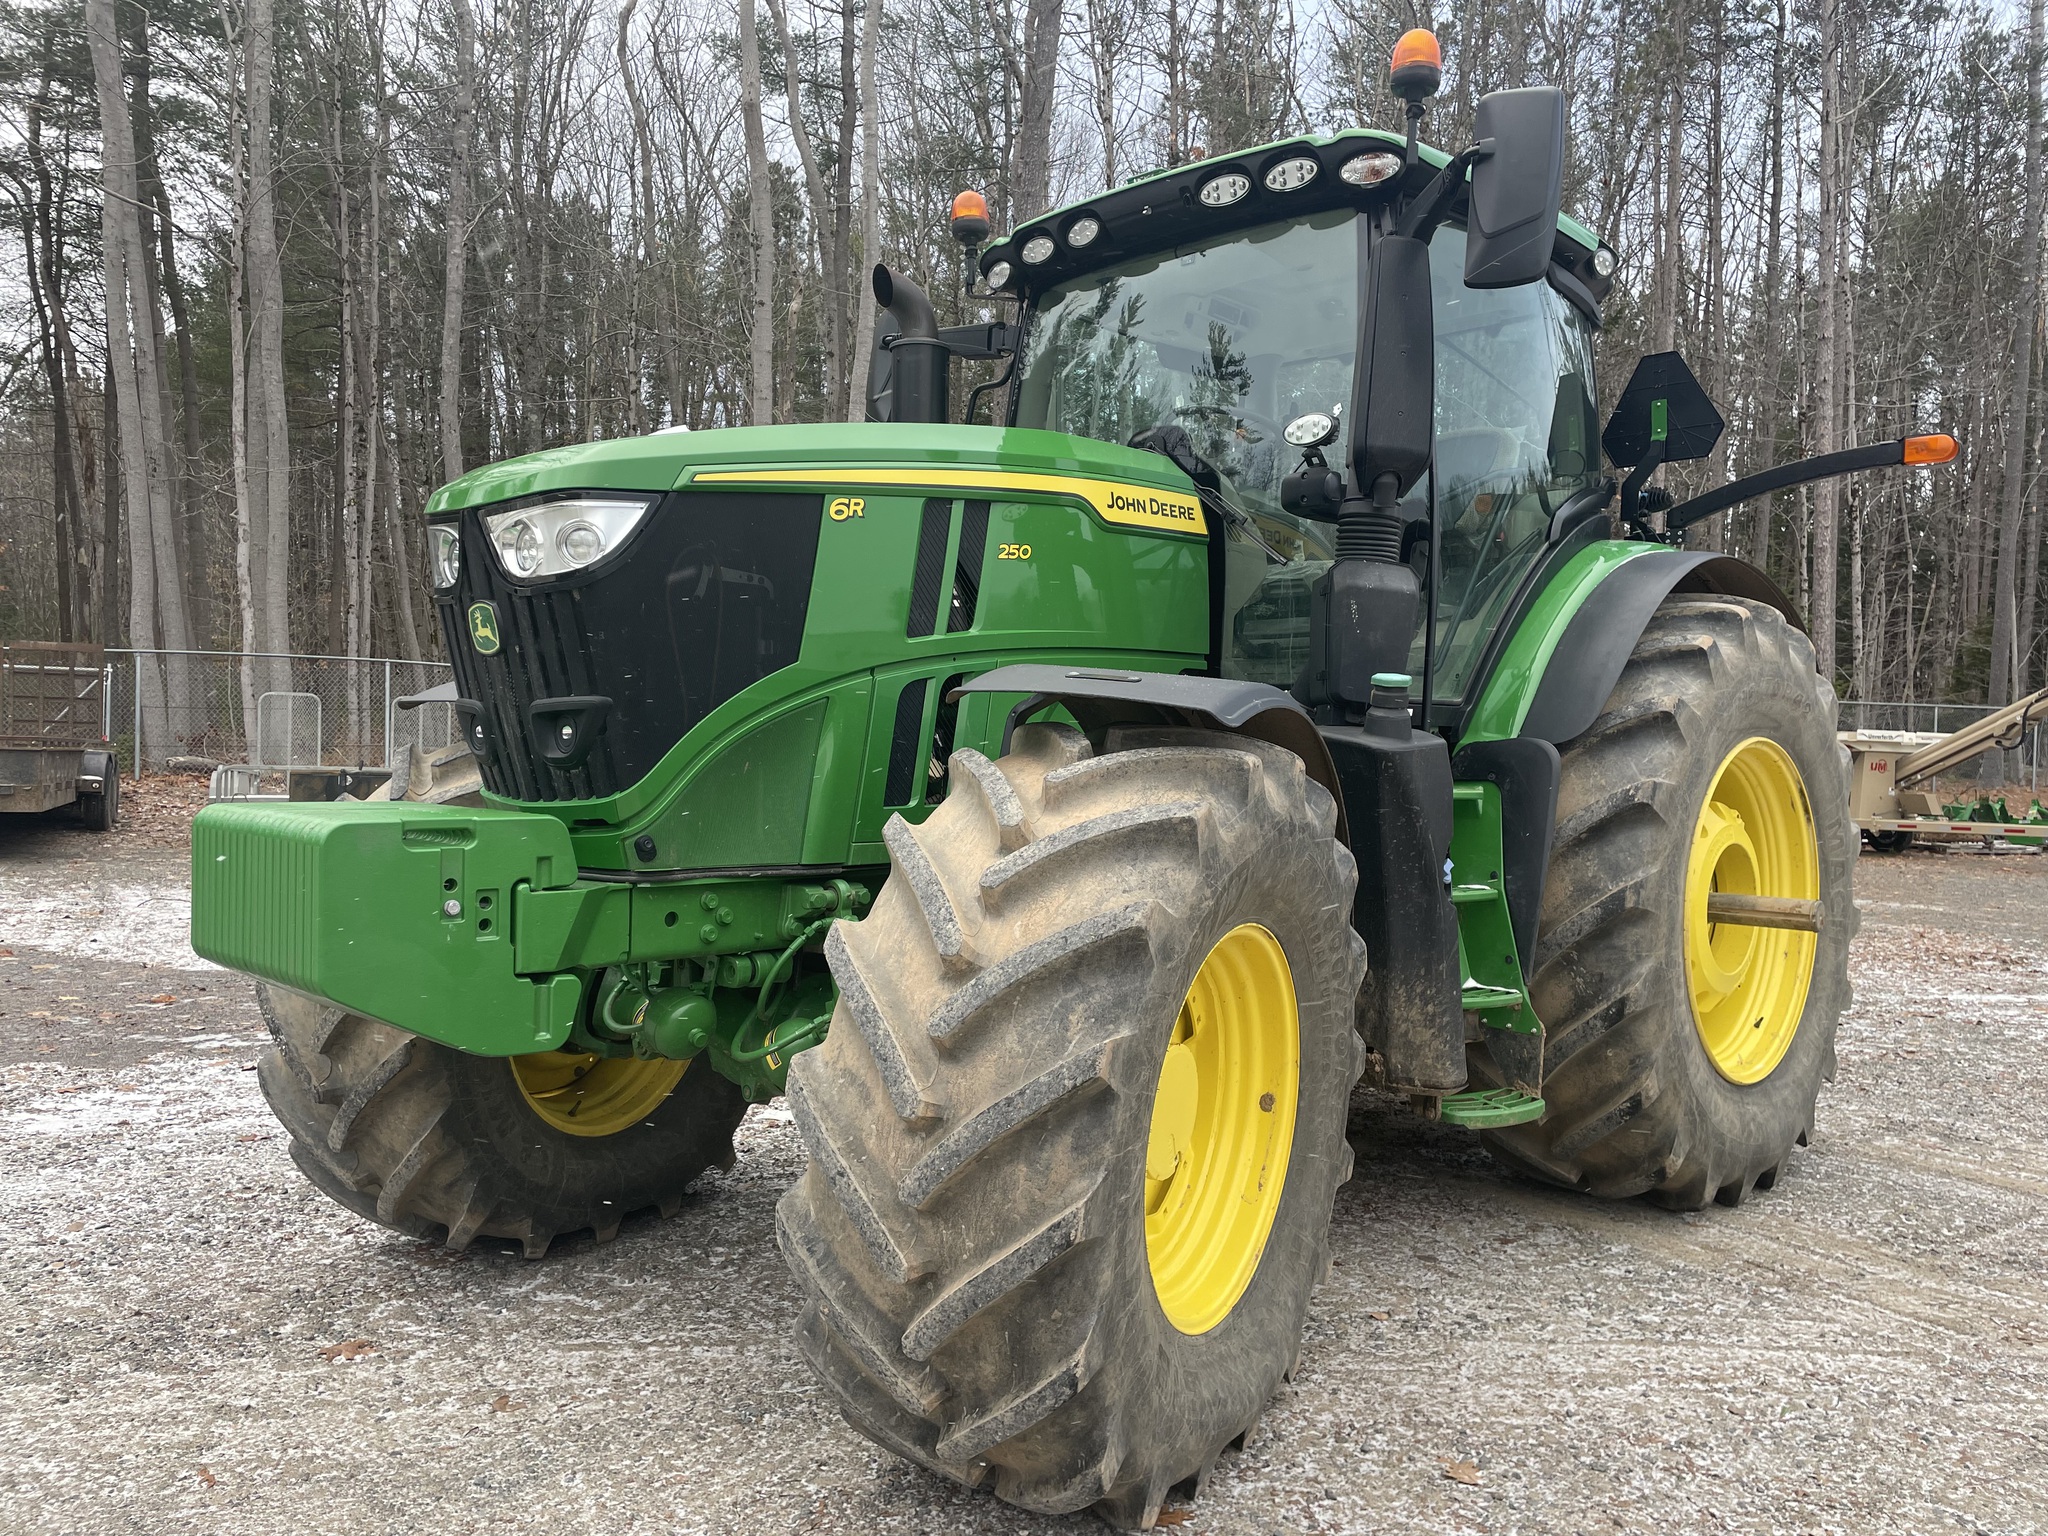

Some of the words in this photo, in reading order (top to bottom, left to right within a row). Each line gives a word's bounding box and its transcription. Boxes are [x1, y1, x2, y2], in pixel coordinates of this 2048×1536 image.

[829, 497, 865, 522] 6R
[1107, 491, 1147, 514] JOHN
[1149, 497, 1196, 521] DEERE
[998, 543, 1032, 560] 250
